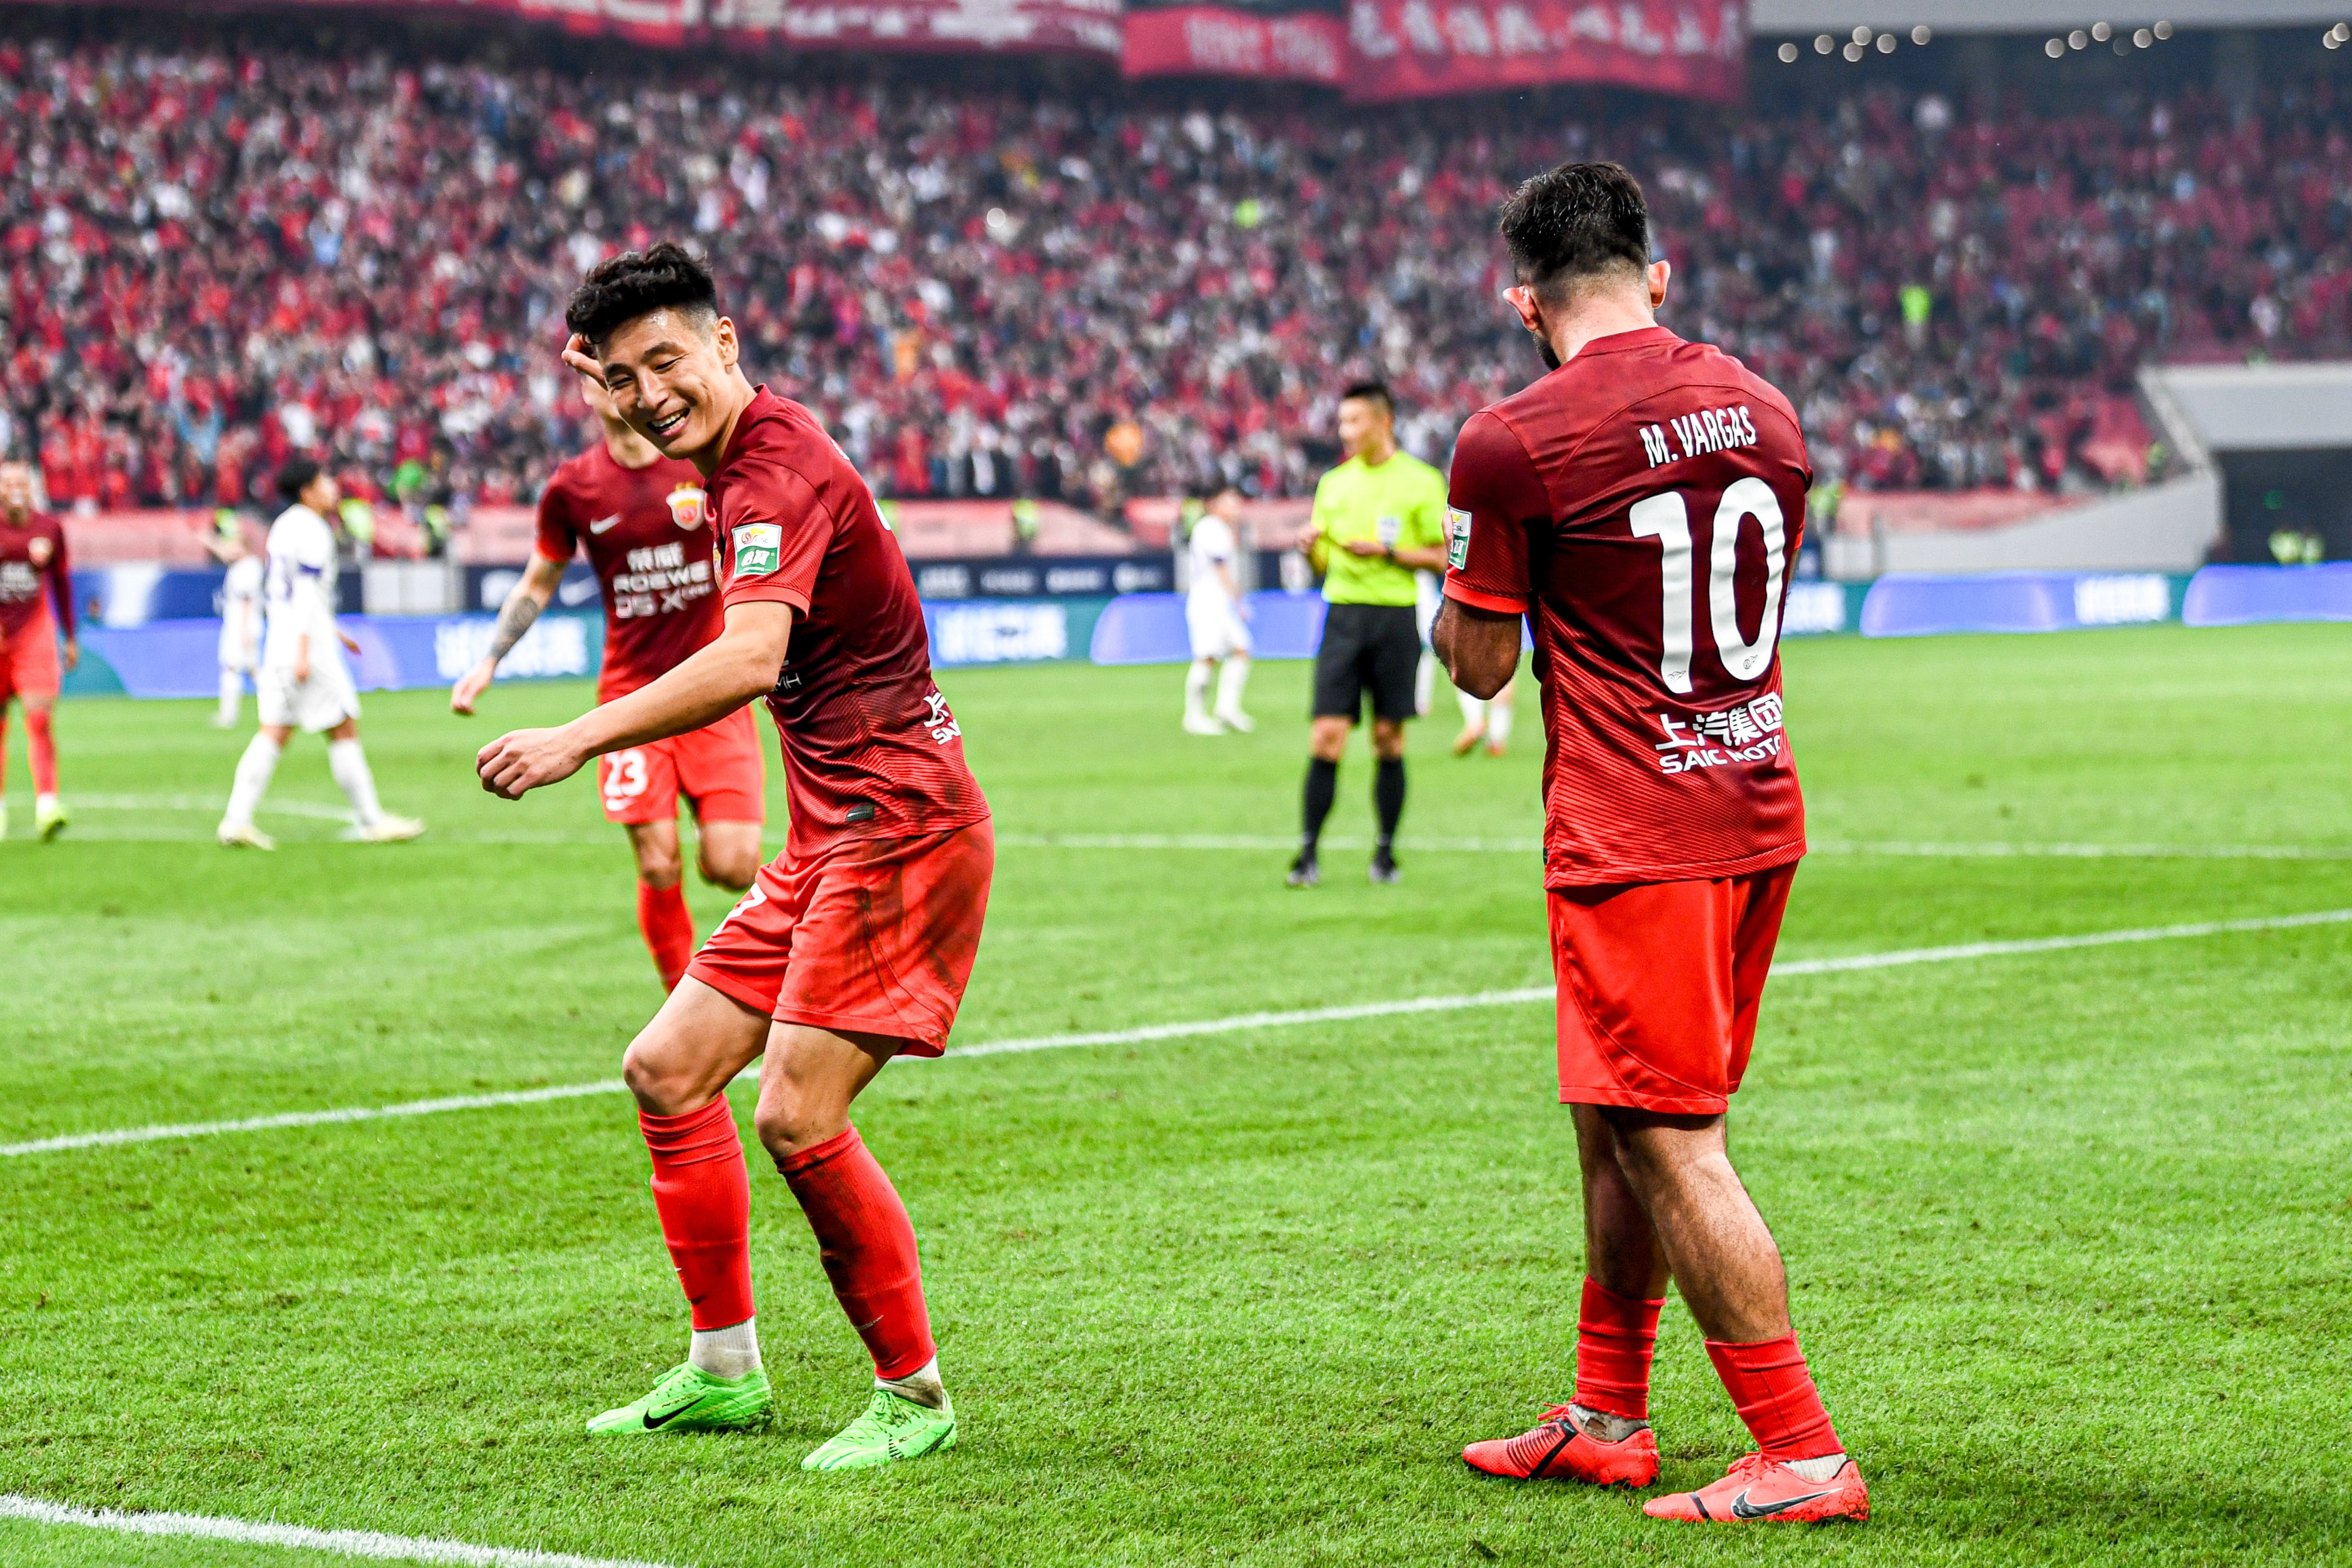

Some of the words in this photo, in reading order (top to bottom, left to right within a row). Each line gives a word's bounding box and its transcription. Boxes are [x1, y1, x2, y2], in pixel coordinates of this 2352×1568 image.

[613, 559, 711, 594] ROEWE
[1629, 477, 1785, 694] 10
[1655, 691, 1782, 750] 上汽集团
[603, 750, 649, 796] 23
[1659, 750, 1728, 774] SAIC
